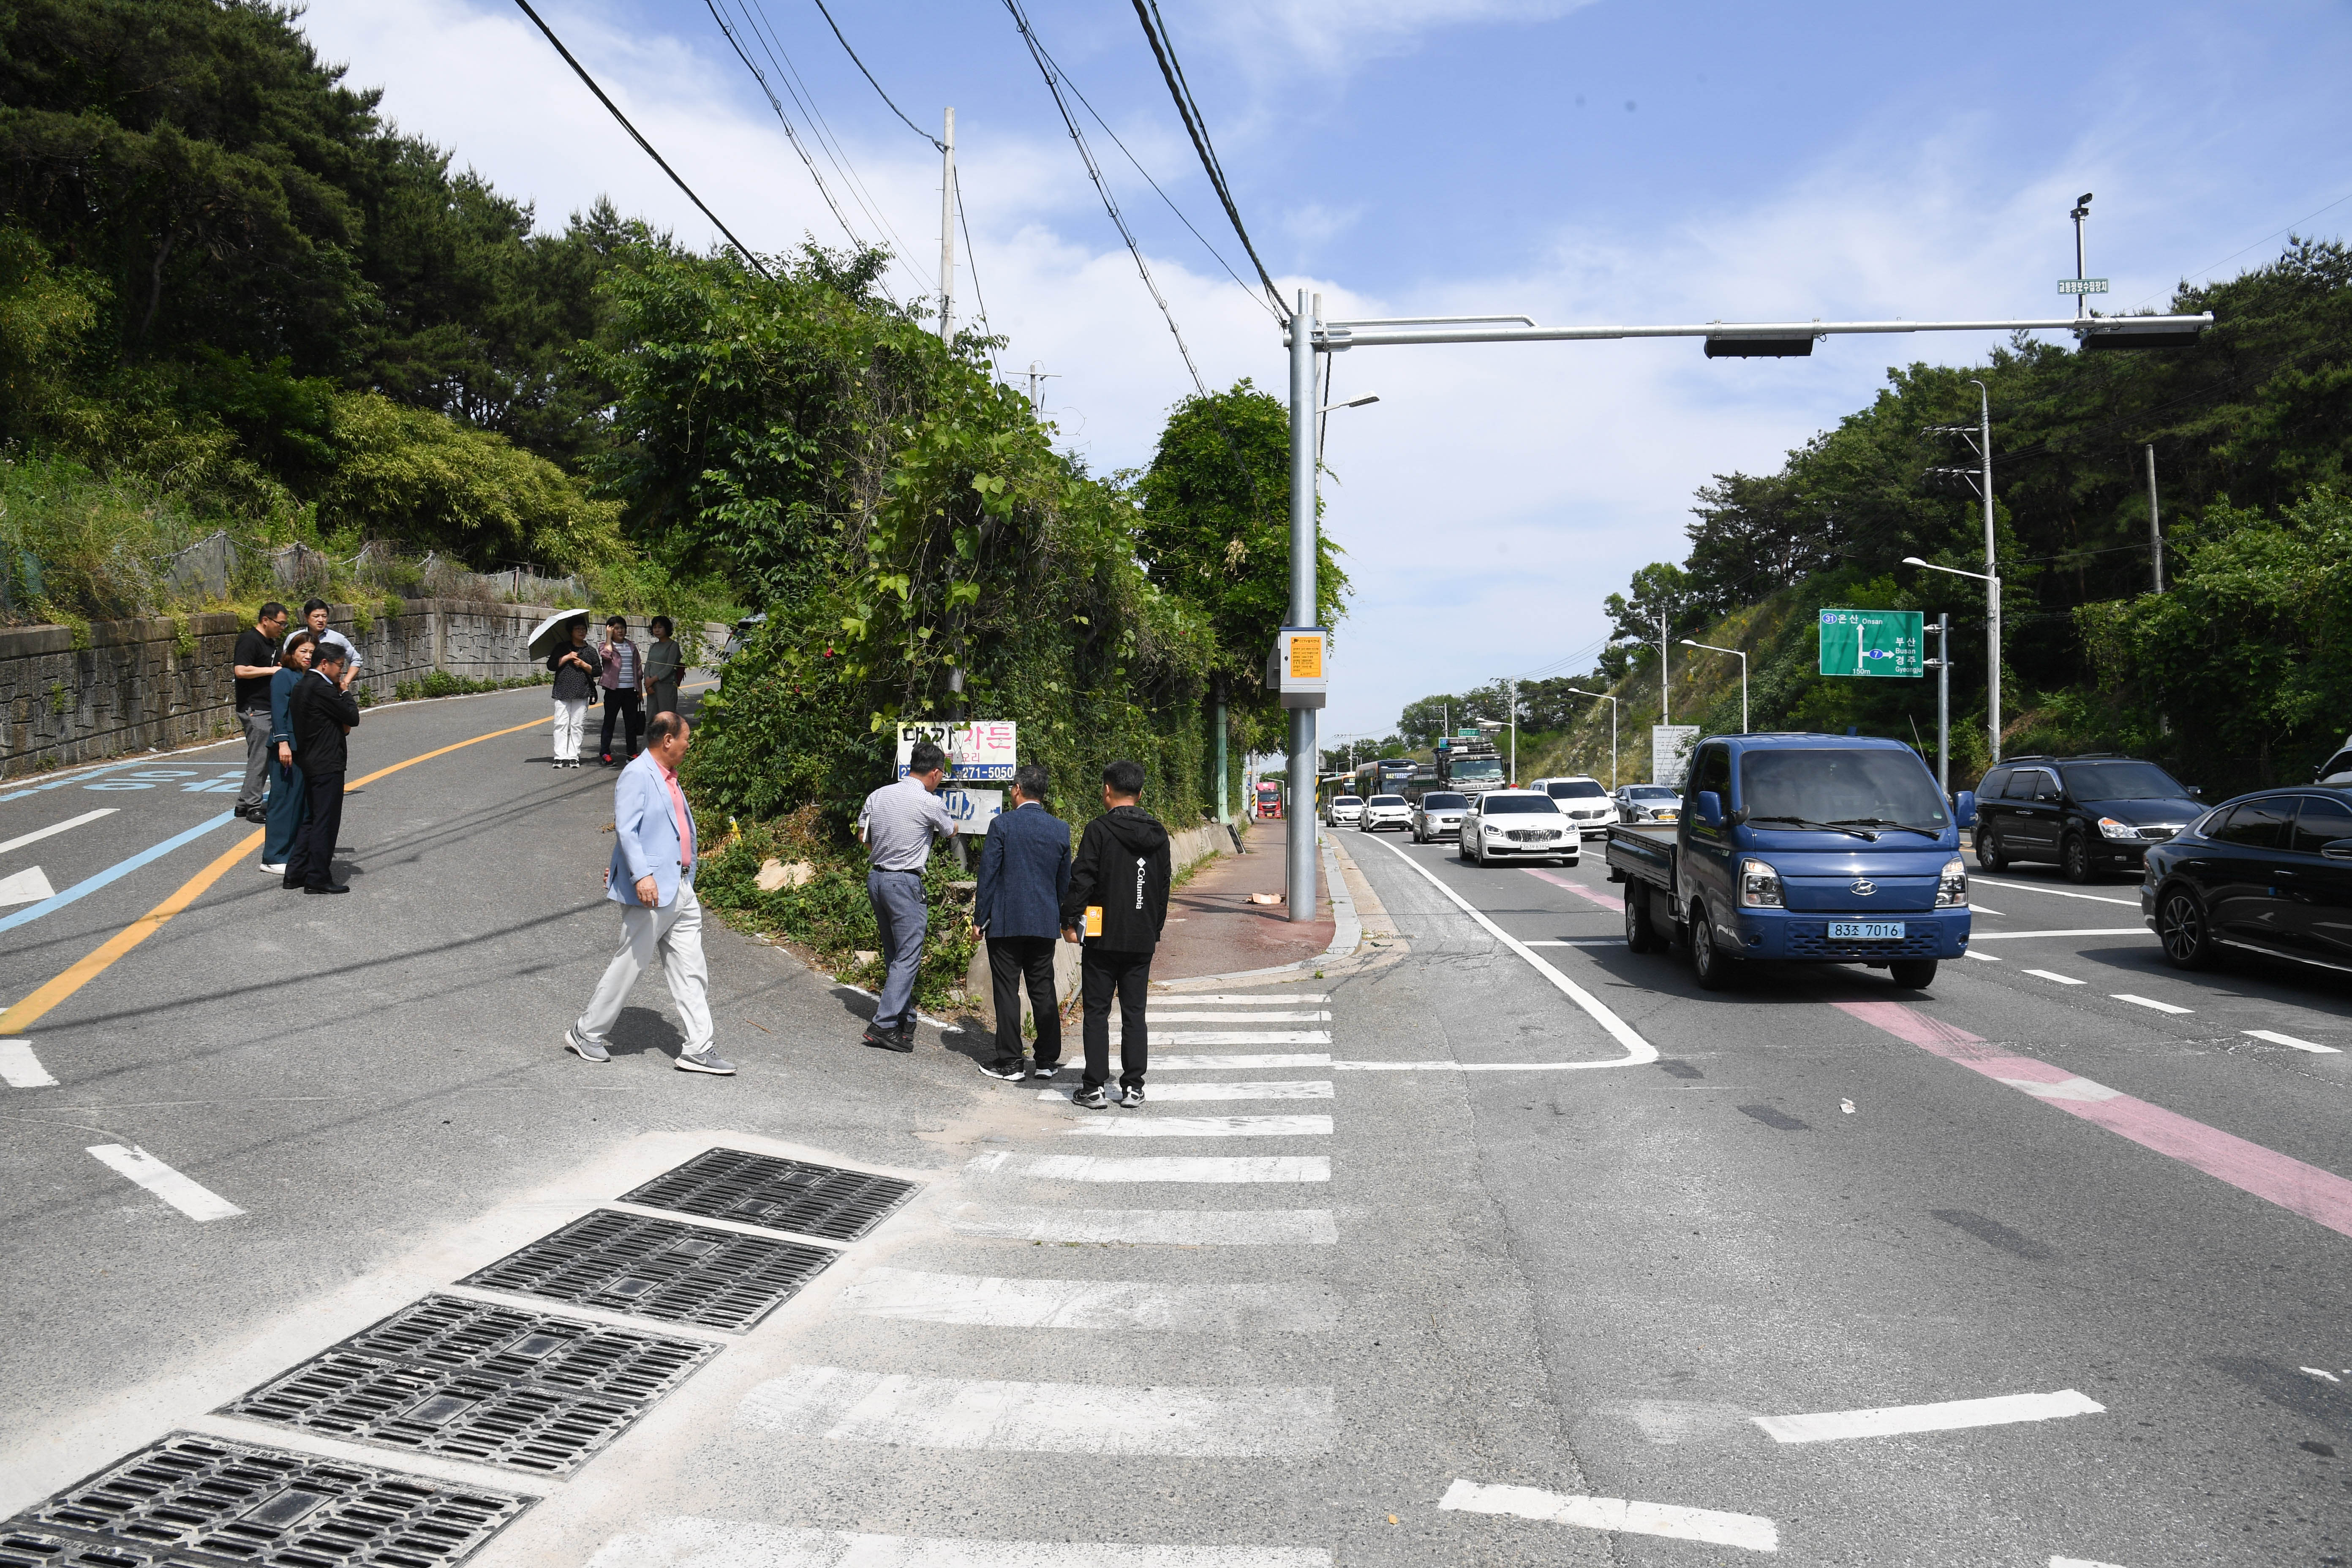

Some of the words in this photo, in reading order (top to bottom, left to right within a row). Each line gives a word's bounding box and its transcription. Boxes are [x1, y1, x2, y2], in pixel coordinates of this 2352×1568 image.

[2059, 281, 2107, 293] 교통정보수집장치
[1895, 637, 1916, 647] 부산
[1895, 656, 1916, 665] 경주
[1135, 867, 1146, 909] Columbia
[1835, 924, 1859, 937] 83조
[1866, 924, 1898, 936] 7016
